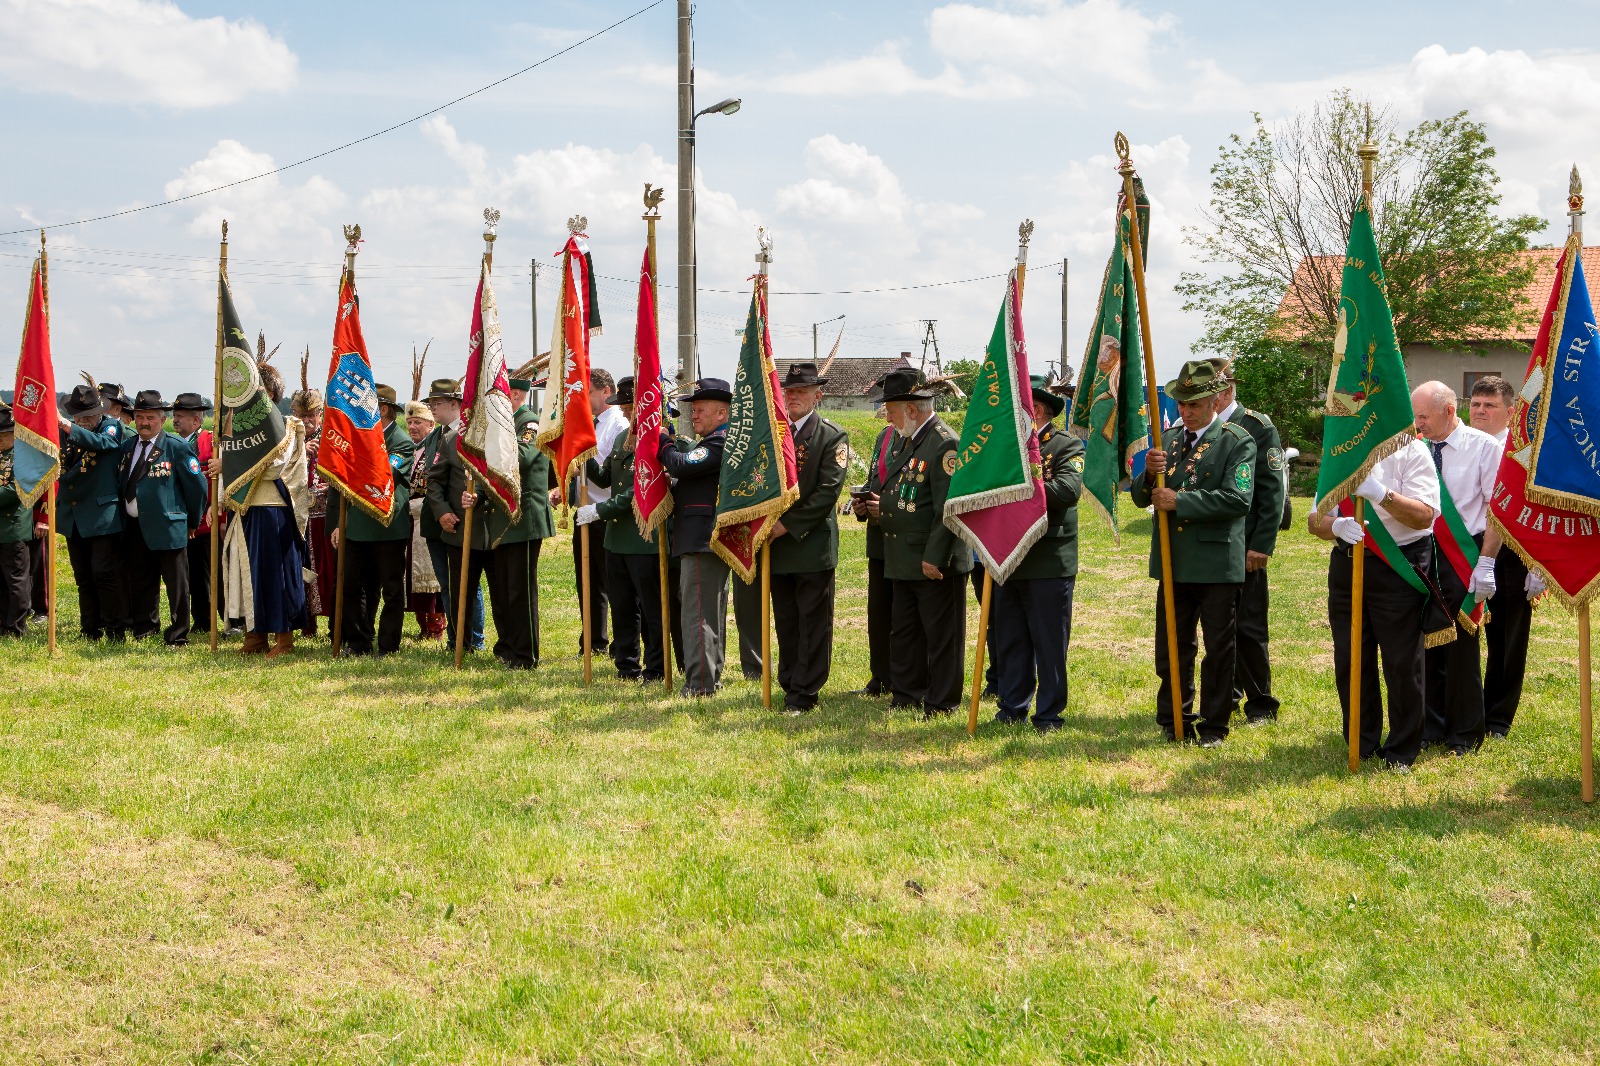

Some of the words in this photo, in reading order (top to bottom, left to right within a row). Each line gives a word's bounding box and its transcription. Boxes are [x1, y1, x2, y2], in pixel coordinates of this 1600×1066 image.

[1344, 256, 1366, 270] AW
[1564, 321, 1599, 382] STRA
[723, 421, 741, 454] TEKLI
[727, 384, 754, 470] STRZELECKIE
[954, 423, 993, 471] STRZE
[1330, 411, 1379, 457] UKOCHANY
[1566, 395, 1600, 477] NICZA
[1492, 481, 1513, 512] NA
